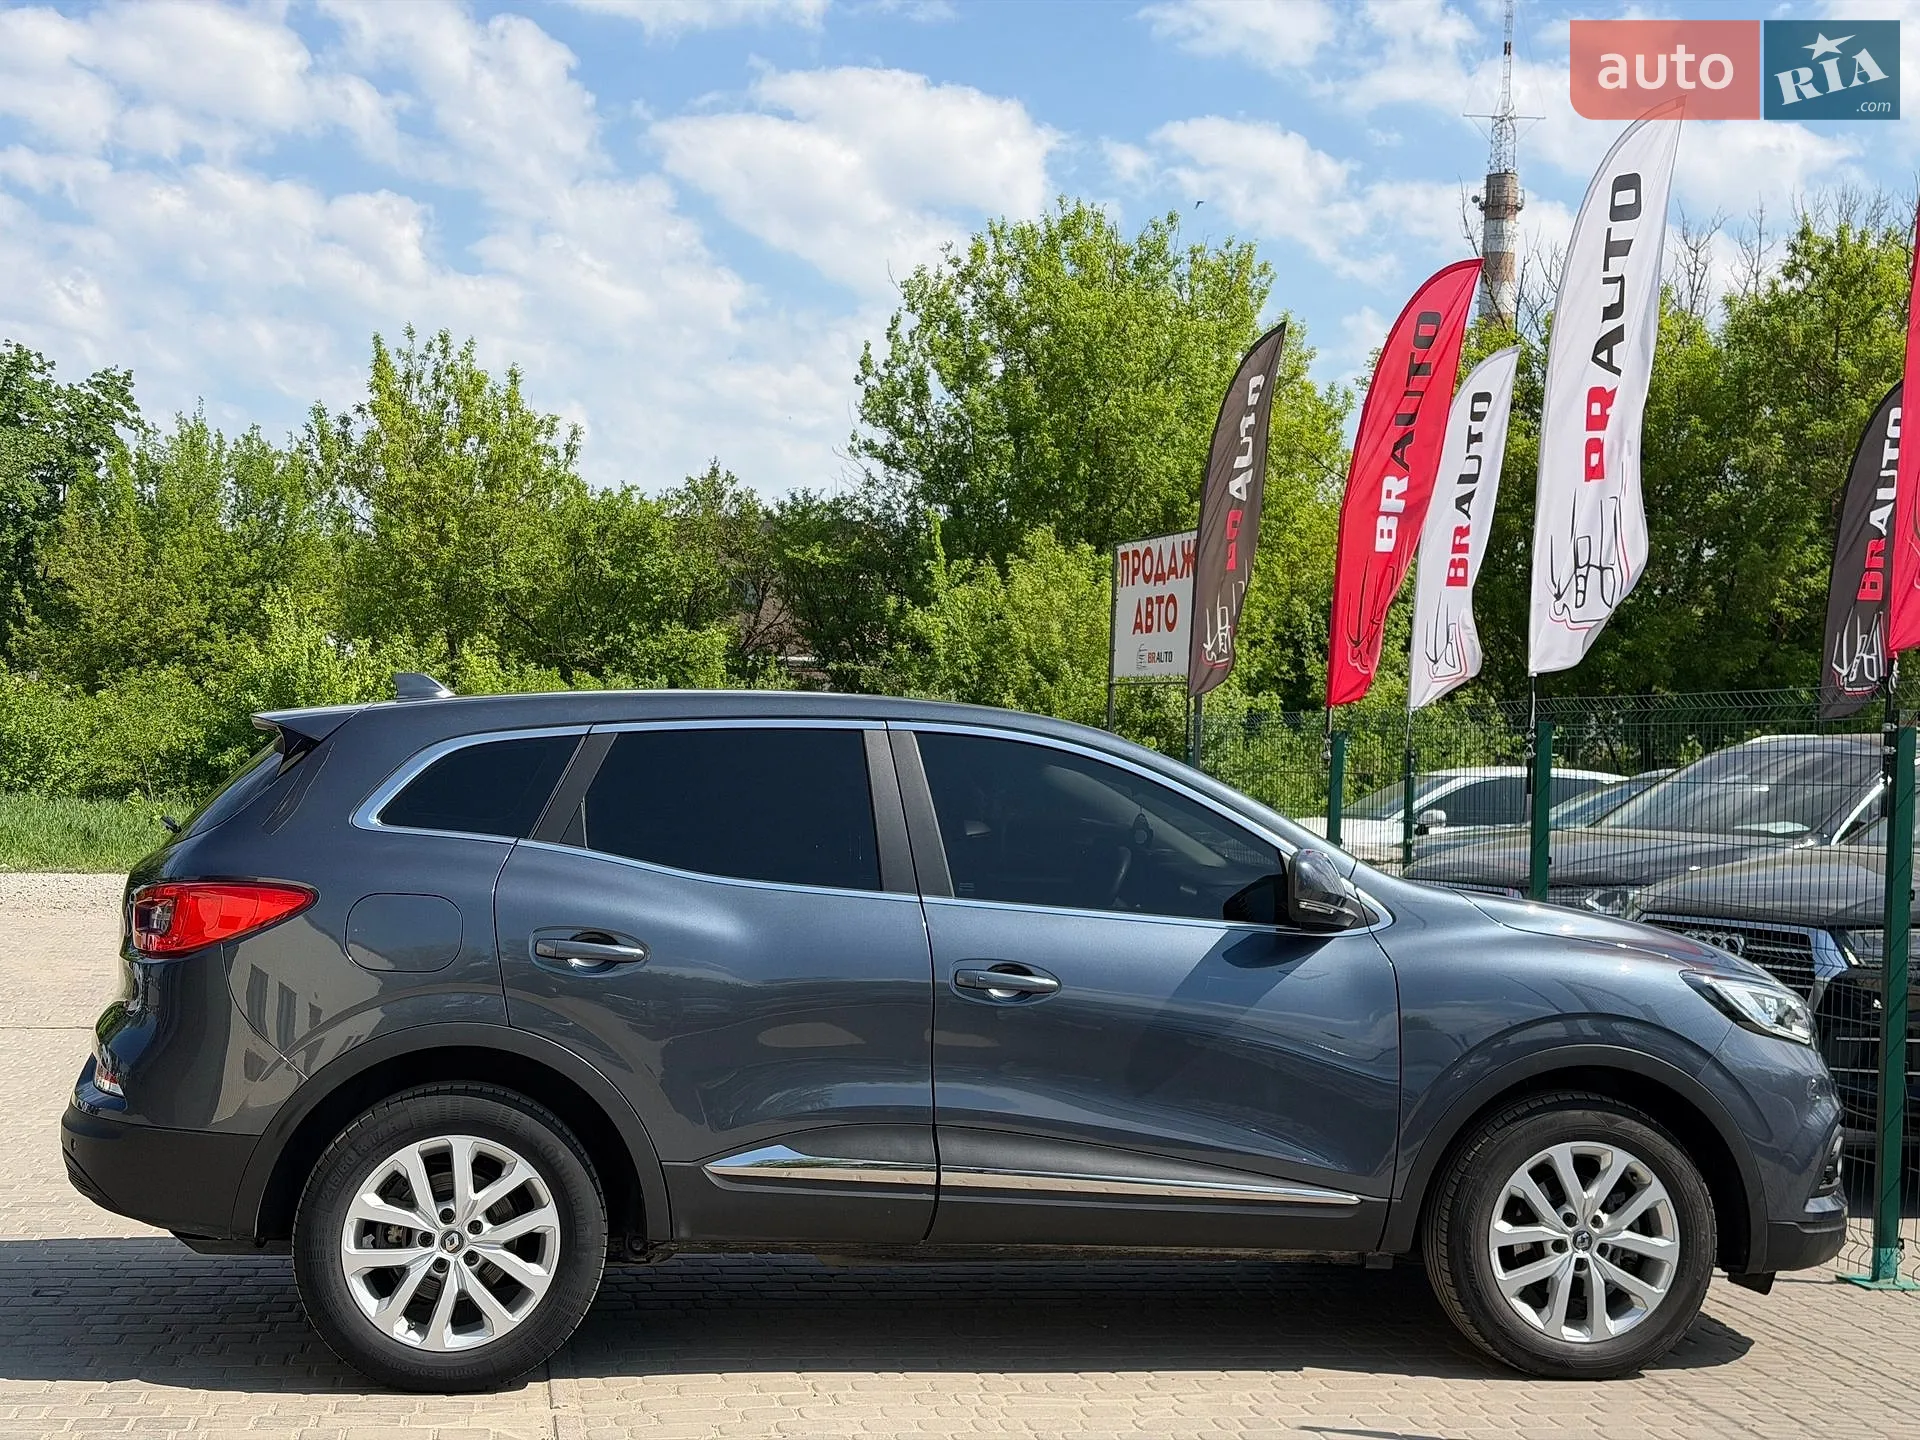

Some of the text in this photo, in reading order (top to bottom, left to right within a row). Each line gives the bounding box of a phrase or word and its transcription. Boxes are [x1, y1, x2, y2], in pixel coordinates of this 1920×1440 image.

[1374, 311, 1442, 553] BRAUTO
[1445, 391, 1493, 587] BRAUTO
[1120, 539, 1197, 588] ПРОДАЖ
[1132, 593, 1178, 635] АВТО
[1147, 650, 1173, 664] BRAUTO
